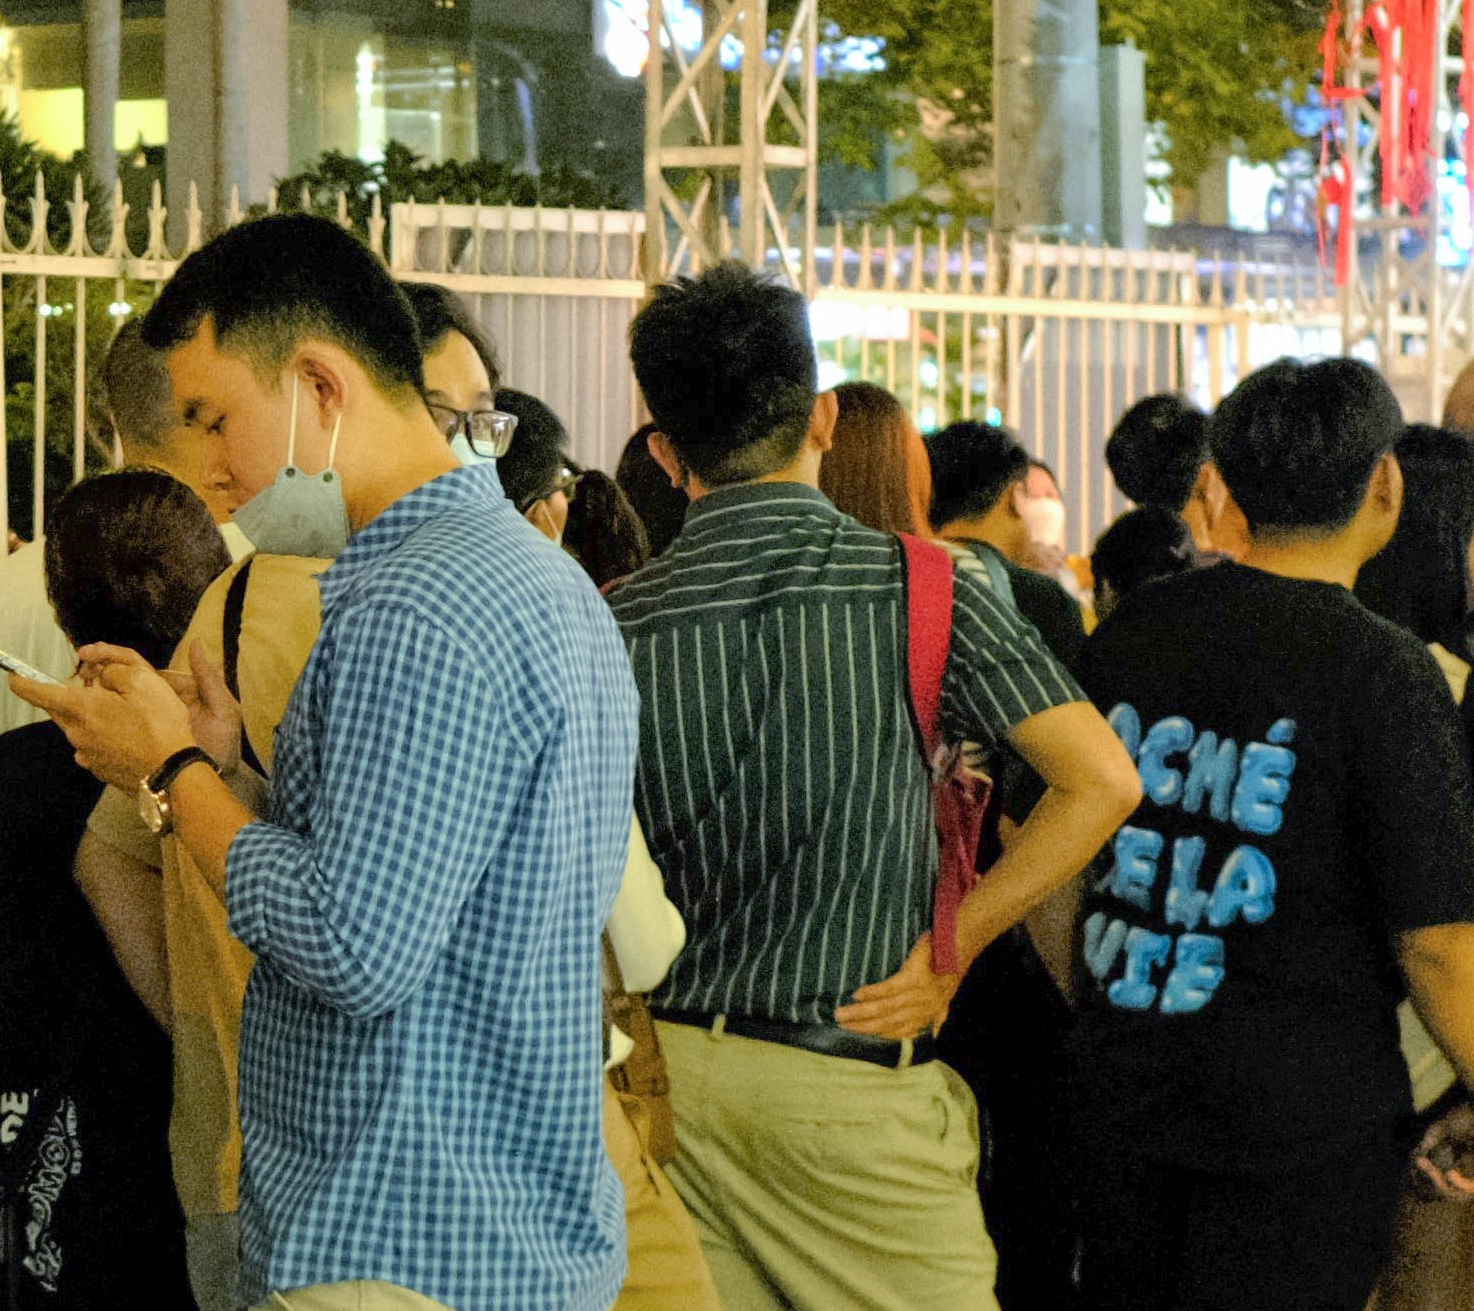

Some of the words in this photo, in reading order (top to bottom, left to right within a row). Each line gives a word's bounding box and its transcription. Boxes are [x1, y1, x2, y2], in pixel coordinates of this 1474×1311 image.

[1096, 825, 1164, 910] E
[1165, 836, 1278, 930] LA
[1084, 911, 1225, 1016] VIE
